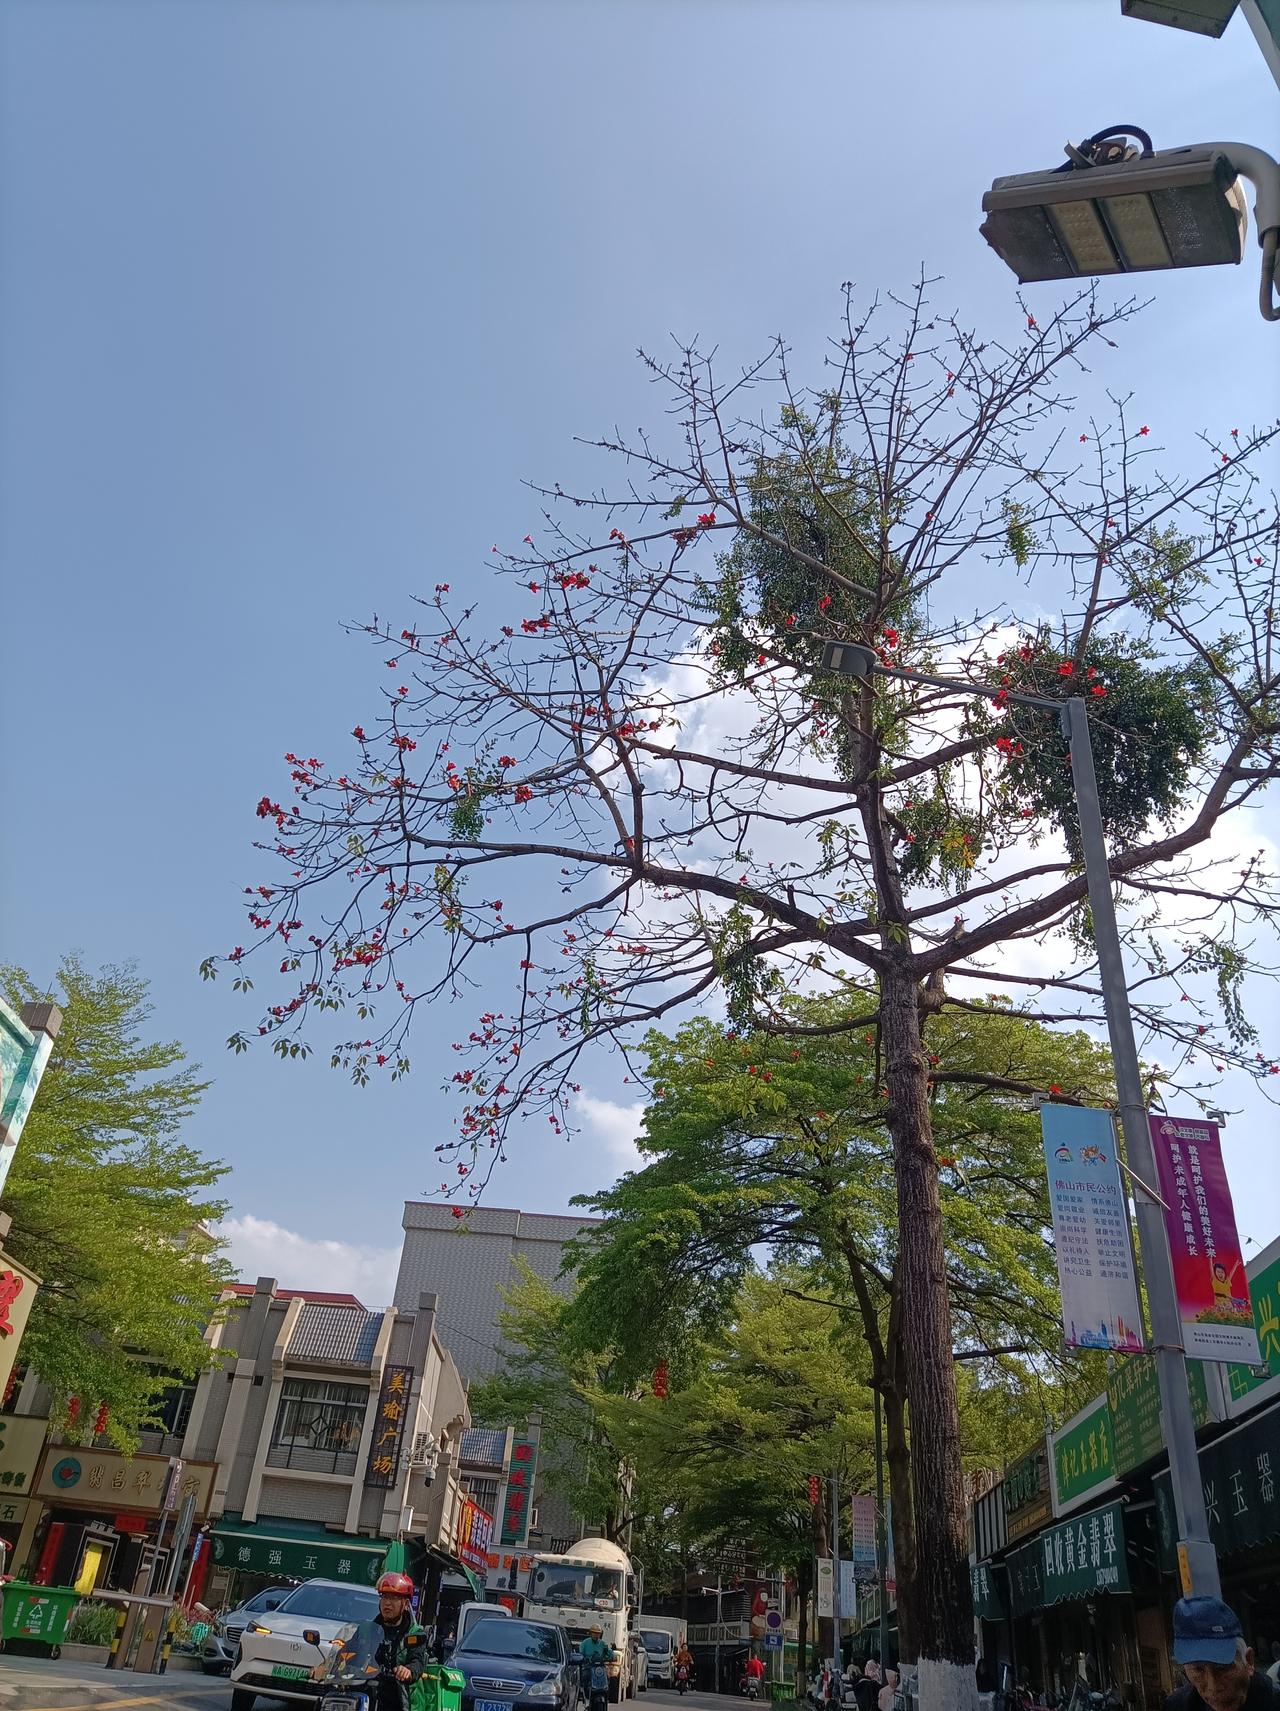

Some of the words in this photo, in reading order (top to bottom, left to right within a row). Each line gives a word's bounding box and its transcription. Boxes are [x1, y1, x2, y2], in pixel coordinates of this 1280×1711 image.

[1055, 1180, 1117, 1196] 佛山市民公约
[1170, 1143, 1198, 1257] 呵护未成年人健康成长
[372, 1367, 406, 1474] 美瑜广场
[238, 1546, 351, 1575] 德强玉器
[1044, 1511, 1117, 1576] 回收黄金翡翠
